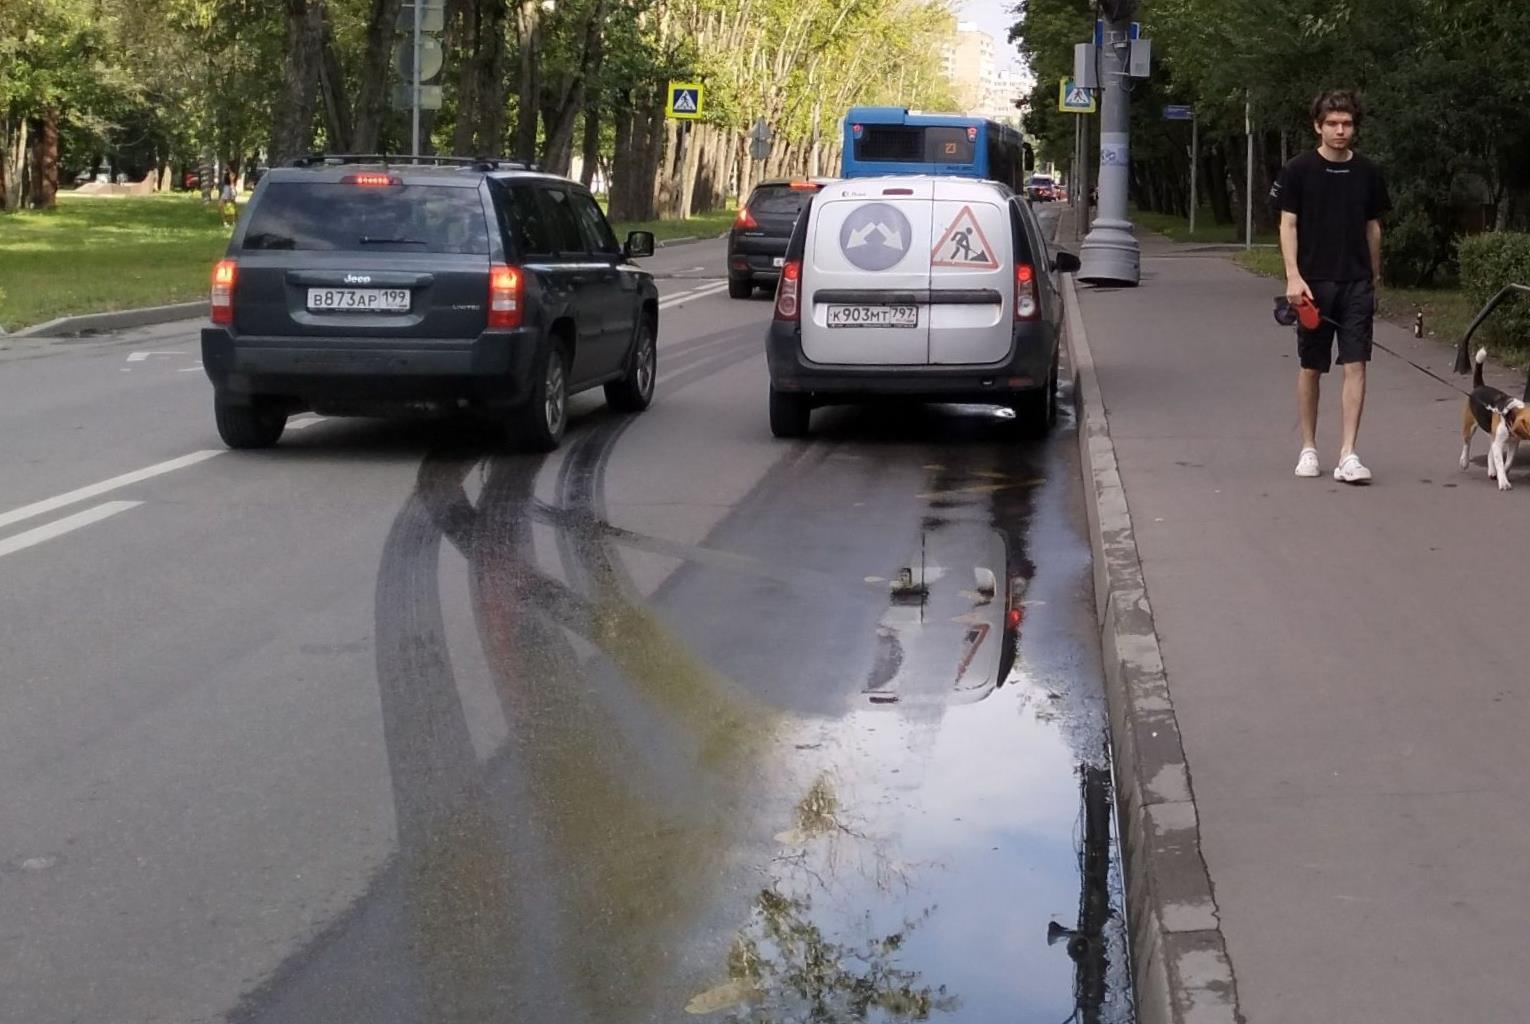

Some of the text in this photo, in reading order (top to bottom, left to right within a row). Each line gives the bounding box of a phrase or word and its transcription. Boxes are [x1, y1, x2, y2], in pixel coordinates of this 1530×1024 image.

[344, 274, 371, 284] Jeep
[382, 291, 407, 303] 199
[892, 308, 914, 318] 797
